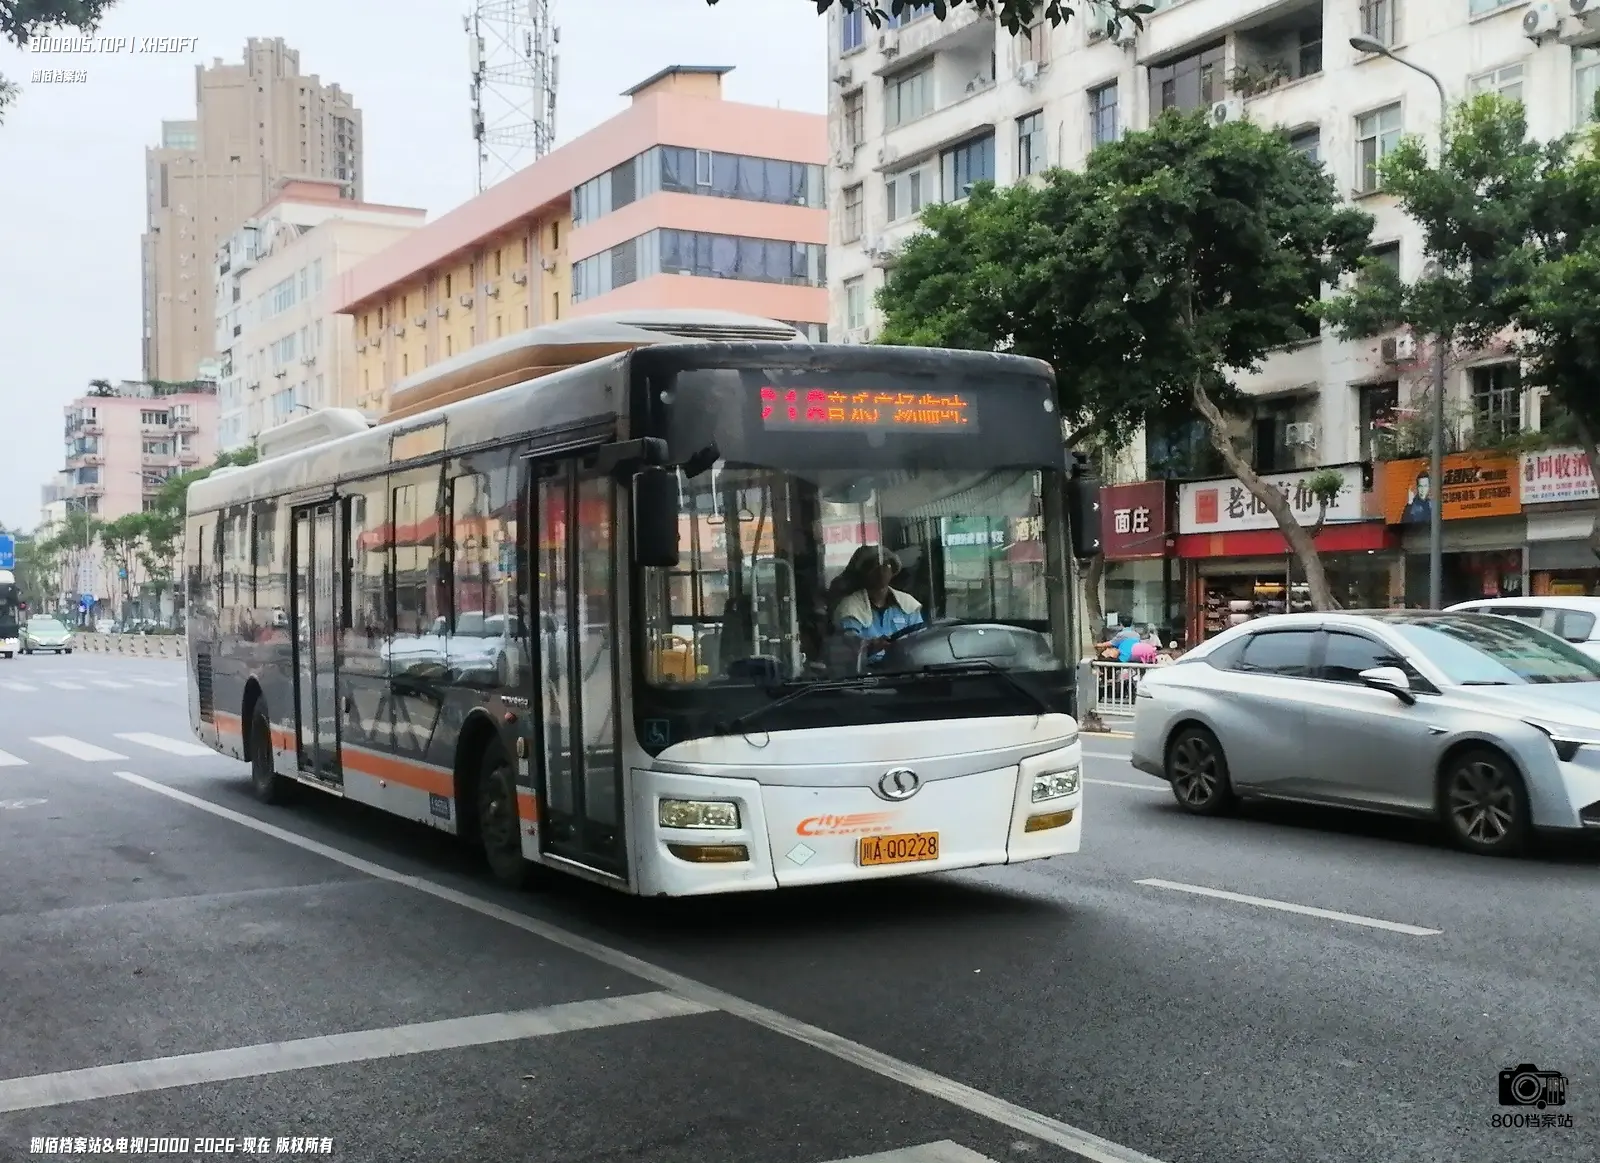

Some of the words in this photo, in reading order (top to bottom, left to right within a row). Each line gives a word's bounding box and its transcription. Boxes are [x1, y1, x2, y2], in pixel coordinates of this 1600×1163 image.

[1224, 478, 1340, 519] 老北布
[1113, 506, 1151, 534] 面庄
[796, 813, 845, 837] City
